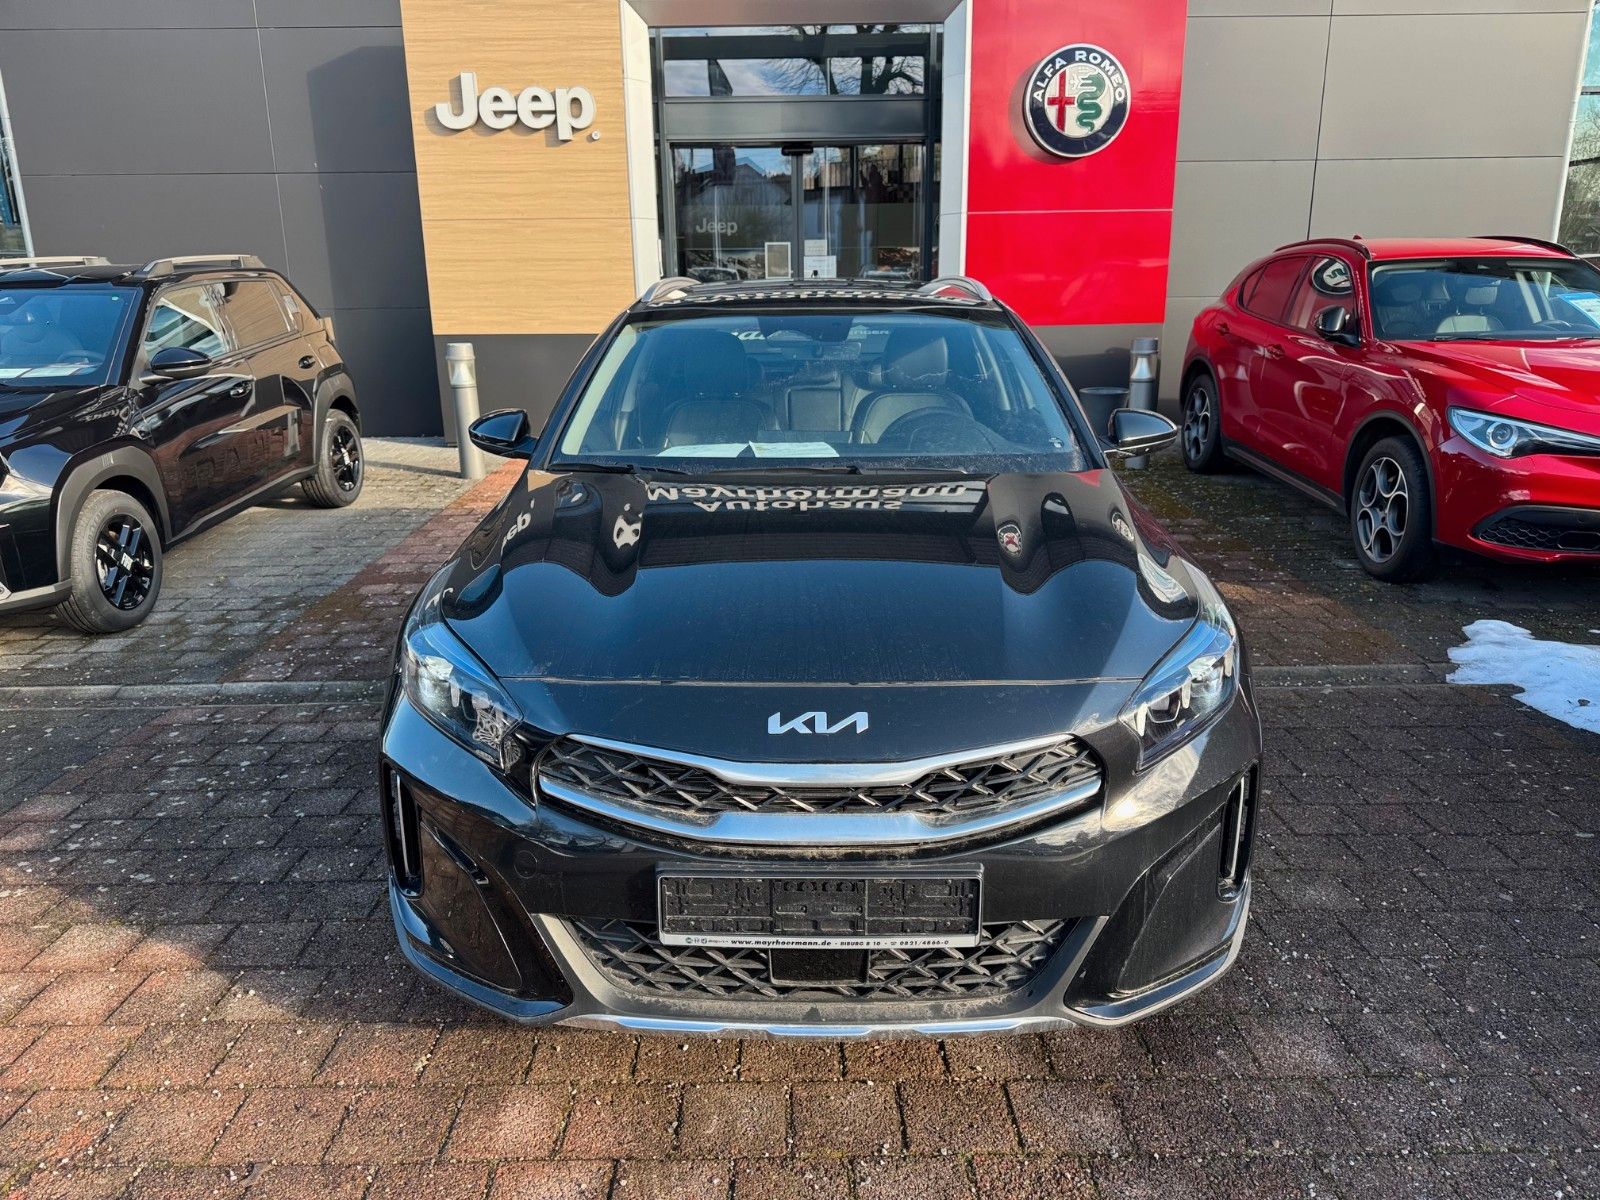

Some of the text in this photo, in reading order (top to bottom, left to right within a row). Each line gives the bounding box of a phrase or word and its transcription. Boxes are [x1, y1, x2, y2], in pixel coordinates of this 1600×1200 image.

[1033, 50, 1126, 102] ALFA ROMEO
[436, 72, 597, 141] Jeep
[695, 218, 738, 236] Jeep
